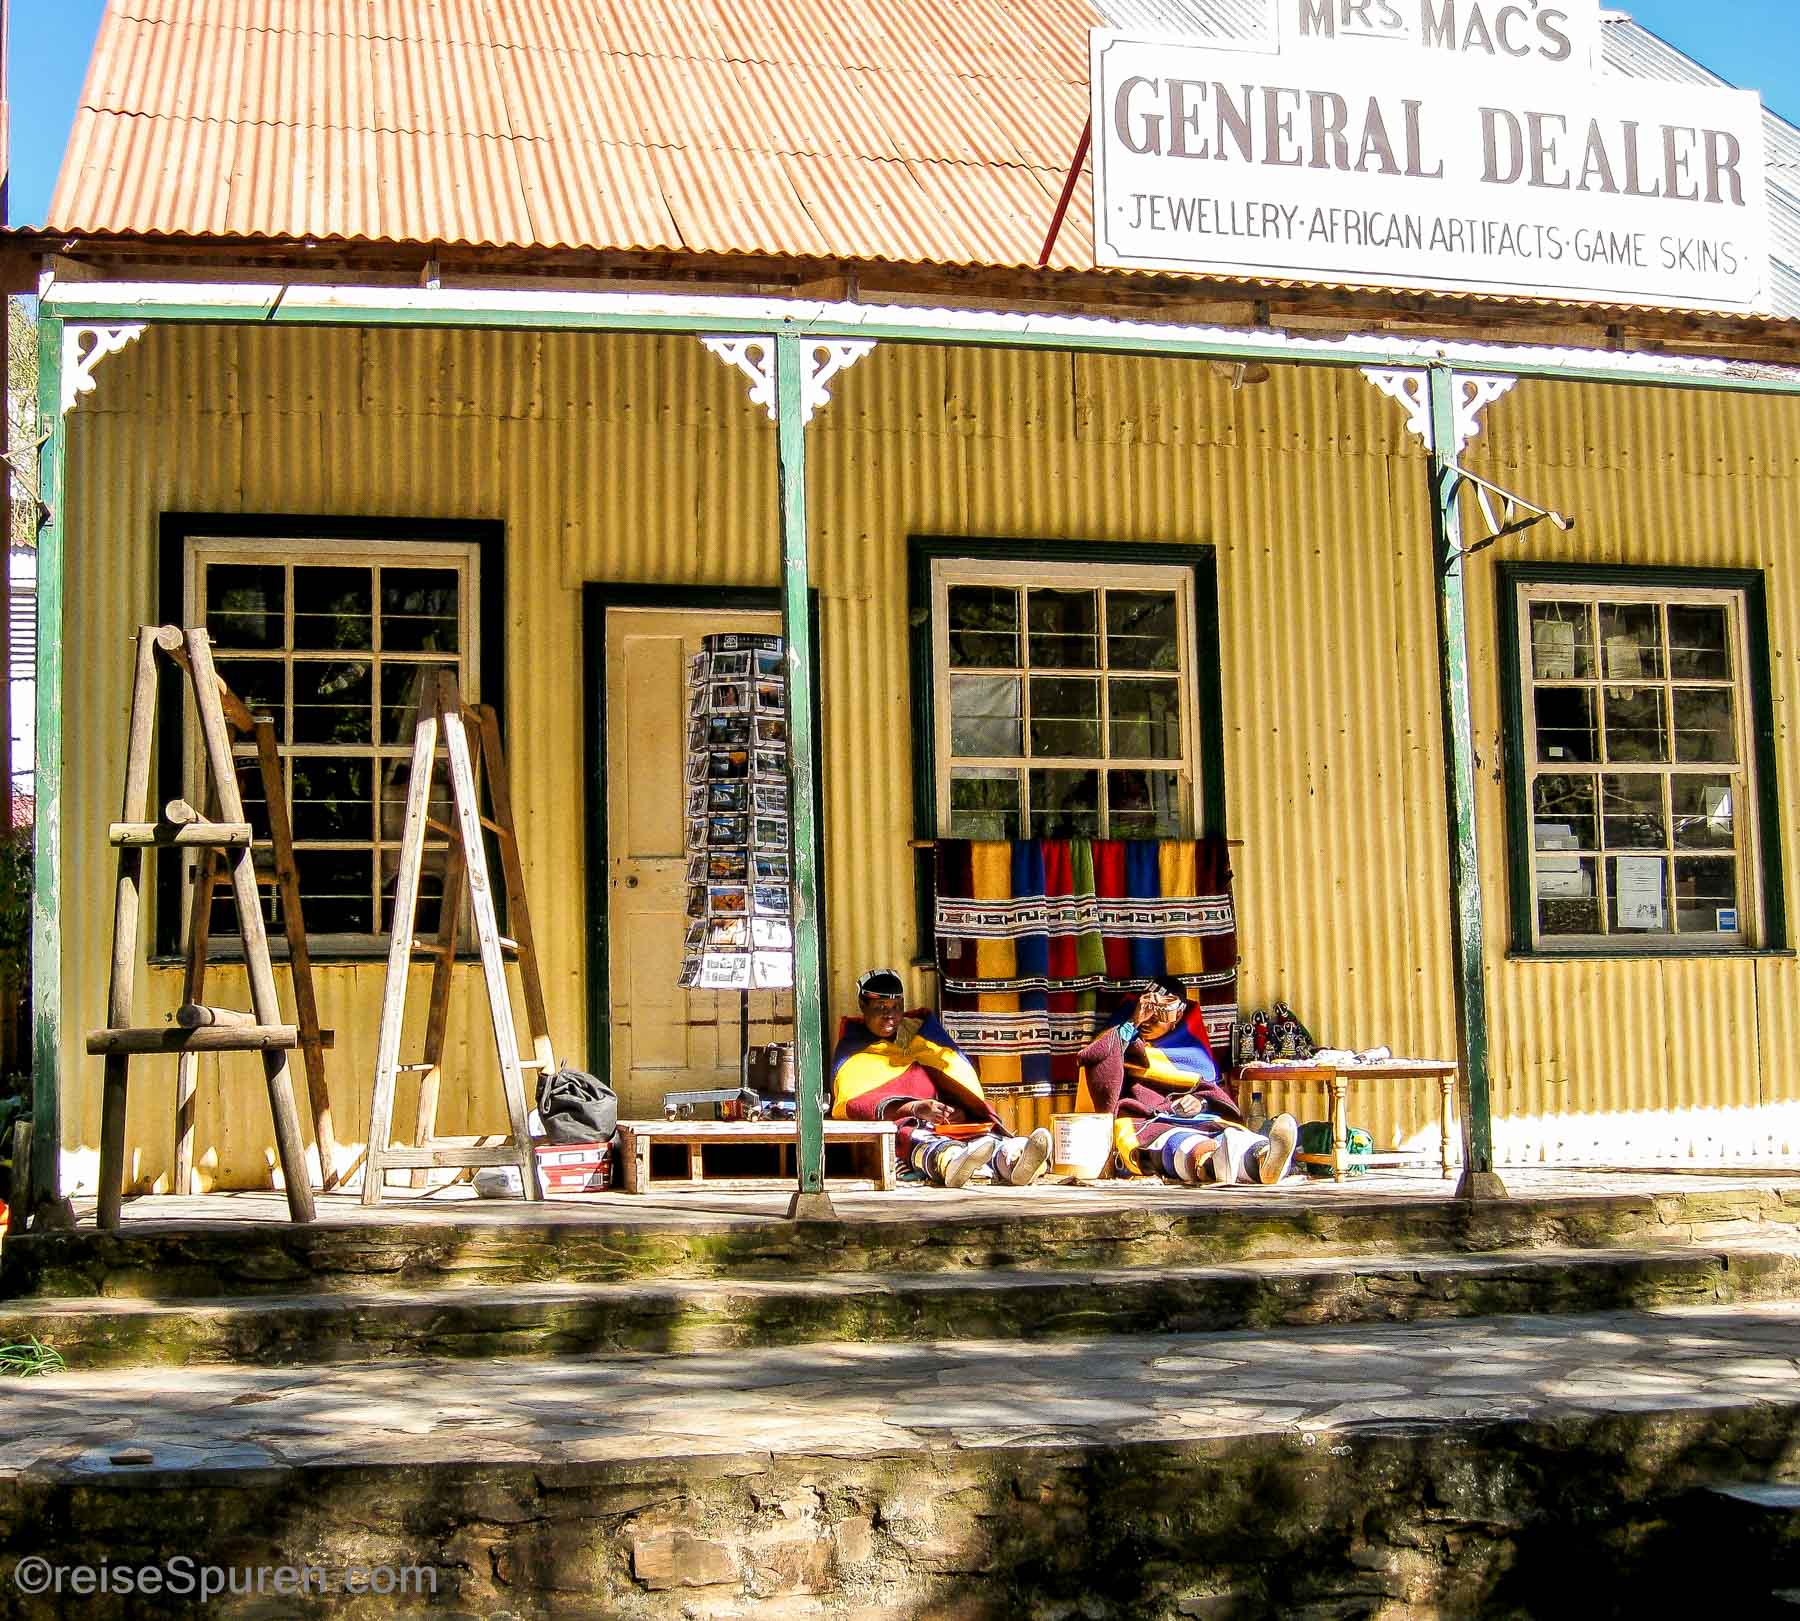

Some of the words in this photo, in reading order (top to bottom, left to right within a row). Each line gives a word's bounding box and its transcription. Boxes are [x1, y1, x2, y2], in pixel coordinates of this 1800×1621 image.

[1114, 75, 1444, 179] GENERAL
[1478, 107, 1746, 207] DEALER
[1308, 206, 1422, 250] AFRICAN
[1429, 216, 1563, 260] ARTIFACTS
[1574, 228, 1648, 268] GAME
[1659, 235, 1738, 275] SKINS
